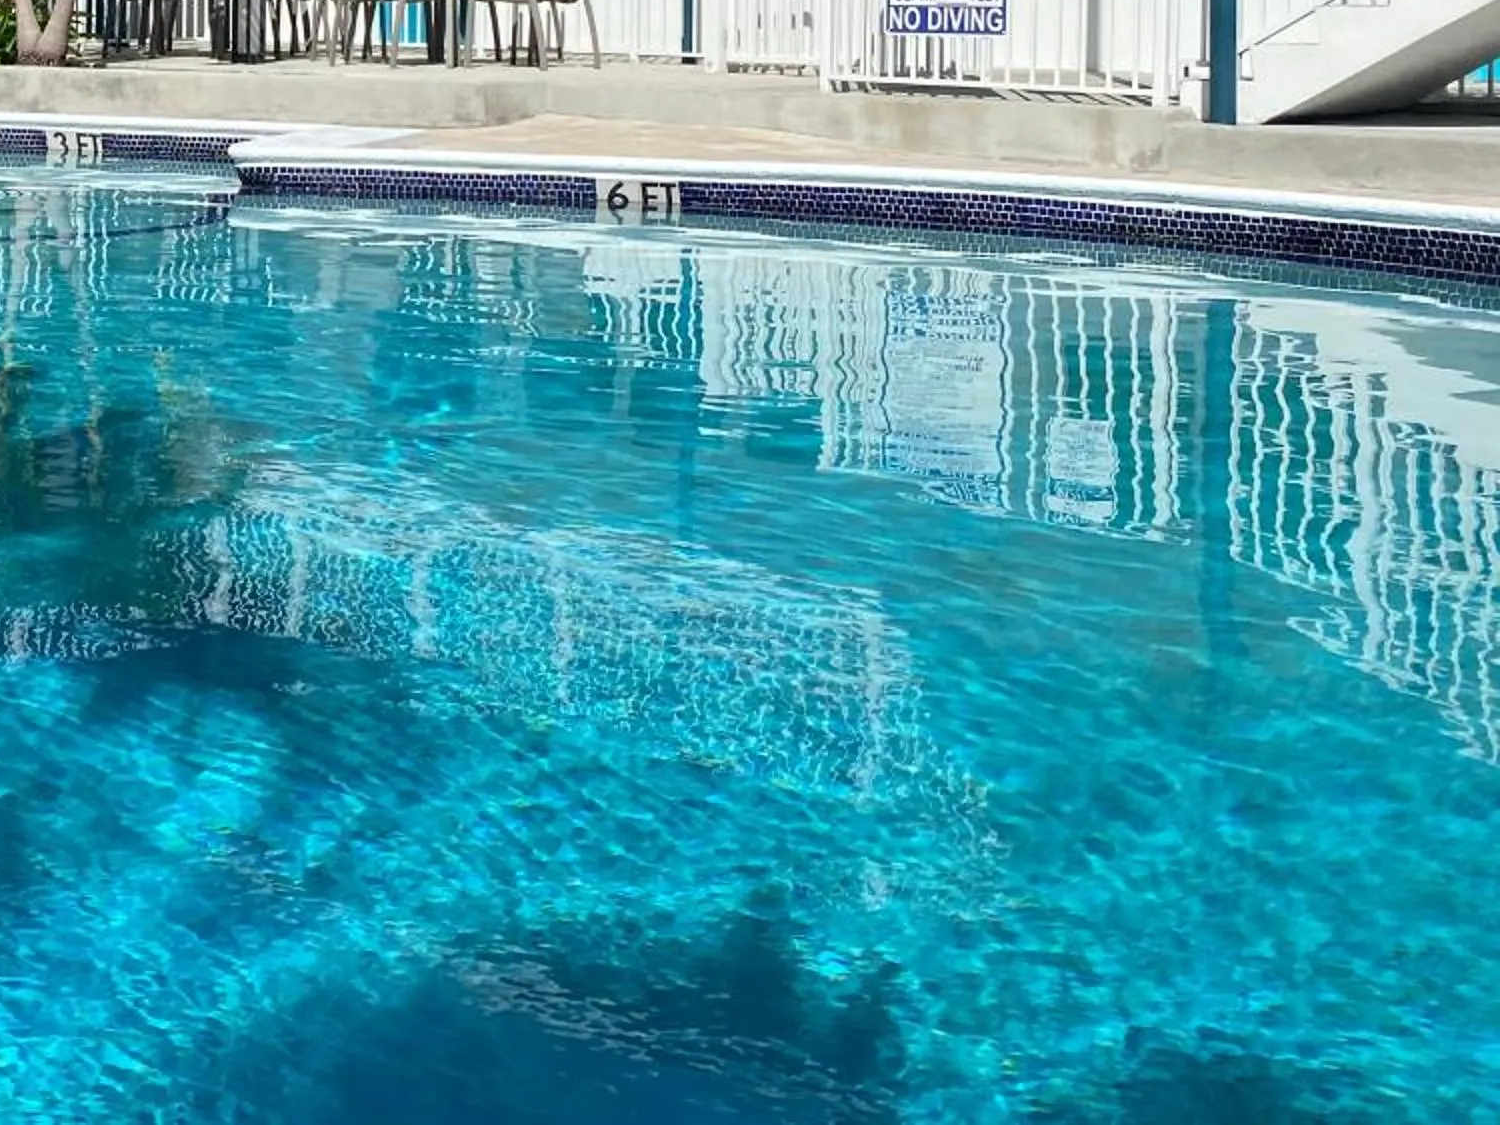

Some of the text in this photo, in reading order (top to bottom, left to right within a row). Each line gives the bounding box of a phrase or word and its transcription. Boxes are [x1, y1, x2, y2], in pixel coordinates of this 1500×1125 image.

[889, 6, 1003, 33] NO DIVING
[53, 131, 69, 159] 3
[607, 181, 629, 211] 6
